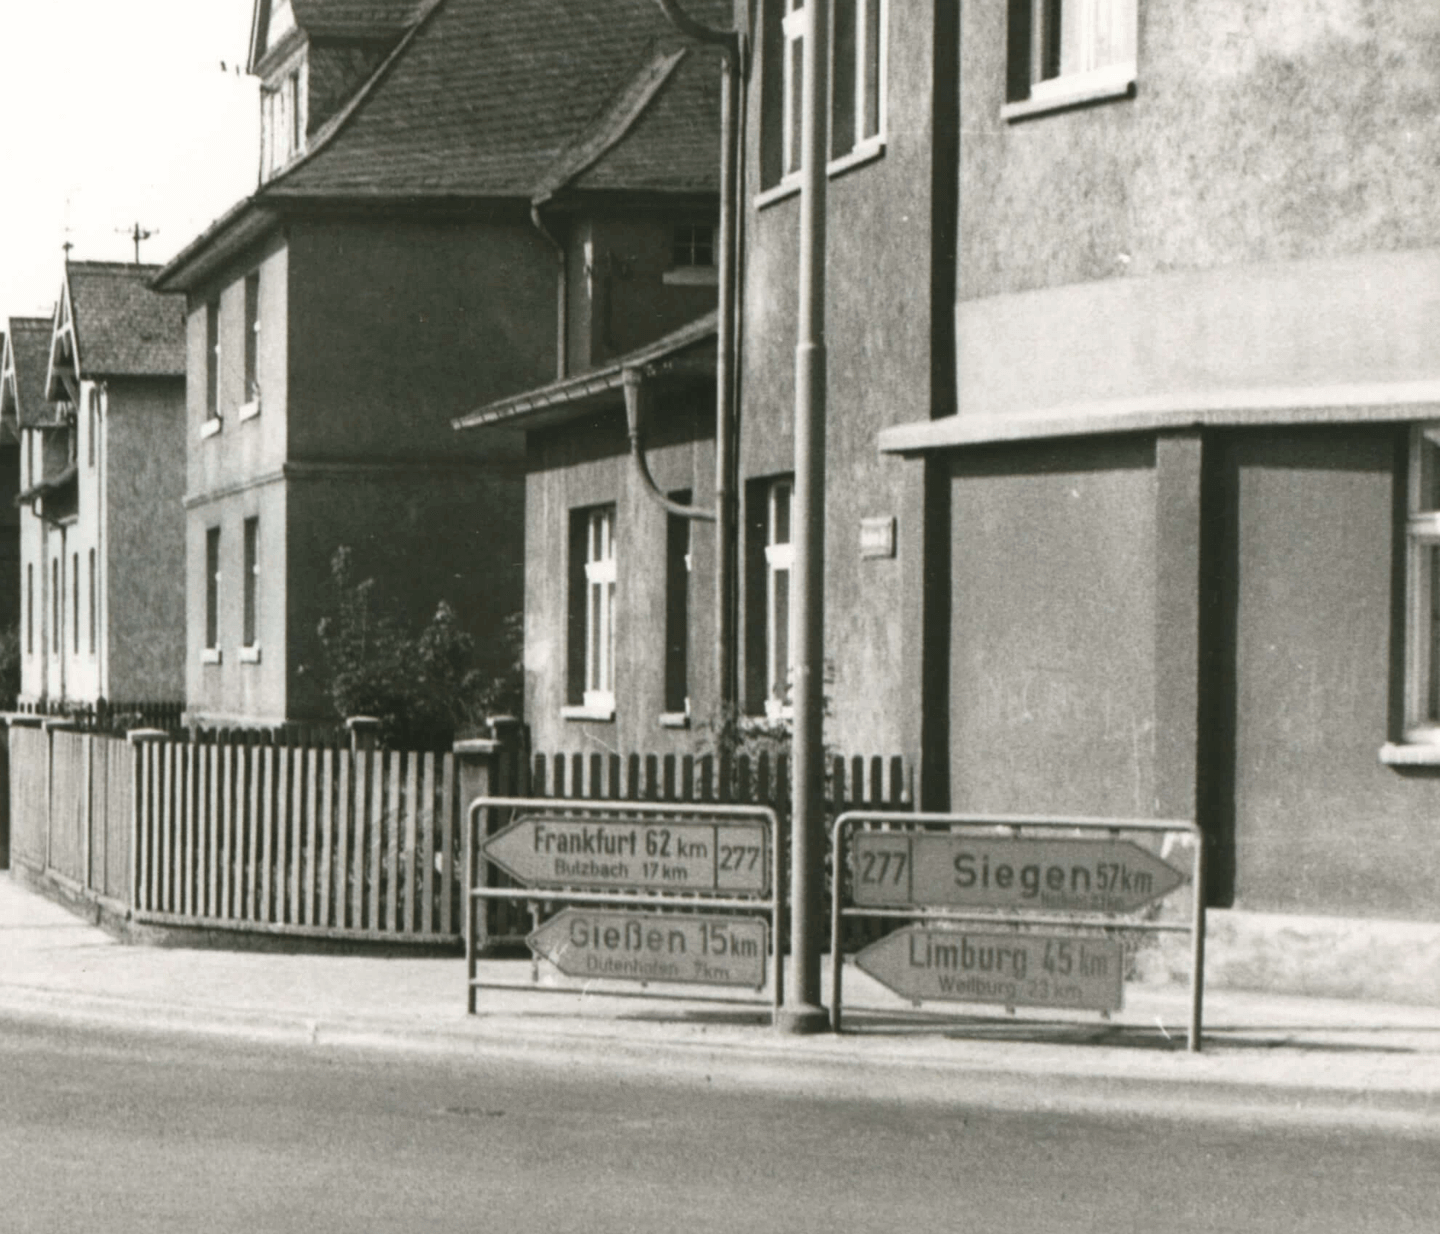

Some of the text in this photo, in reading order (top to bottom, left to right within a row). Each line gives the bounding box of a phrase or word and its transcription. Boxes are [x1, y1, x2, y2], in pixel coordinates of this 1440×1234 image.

[533, 826, 707, 859] Frankfurt 62 km
[719, 845, 759, 871] 277
[554, 858, 688, 880] Butzbach 17 km
[862, 852, 907, 886] 277
[953, 853, 1091, 898] Siegen
[569, 917, 686, 952] Gießen
[910, 931, 1108, 978] Limburg 45 km
[938, 974, 1016, 1000] Weilburg
